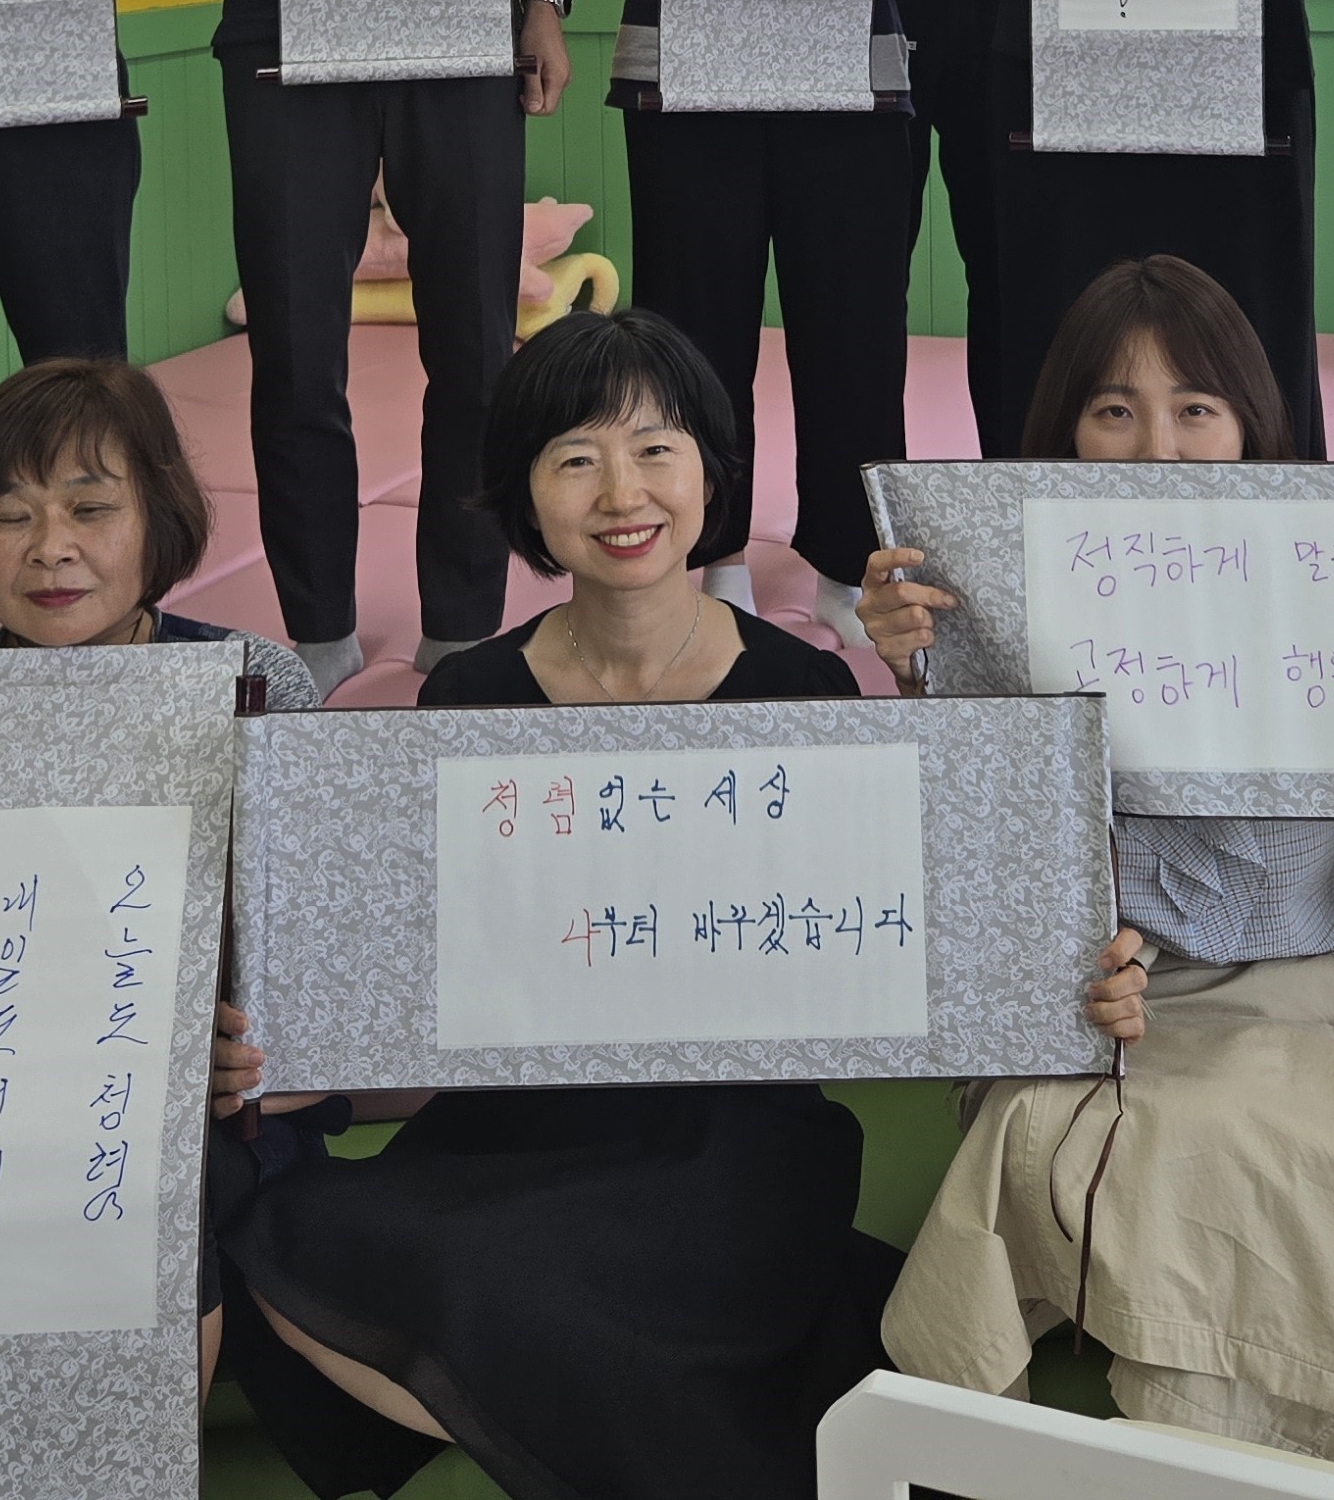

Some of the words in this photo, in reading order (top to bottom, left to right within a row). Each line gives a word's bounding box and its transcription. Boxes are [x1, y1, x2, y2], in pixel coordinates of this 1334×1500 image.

[1065, 529, 1250, 598] 정직하게
[481, 774, 576, 838] 청렴
[598, 773, 676, 833] 없는
[703, 763, 791, 826] 세상
[96, 863, 154, 1046] 오늘도
[560, 903, 659, 968] 나부터
[691, 891, 915, 957] 바꾸겠습니다
[82, 1071, 133, 1223] 청렴
